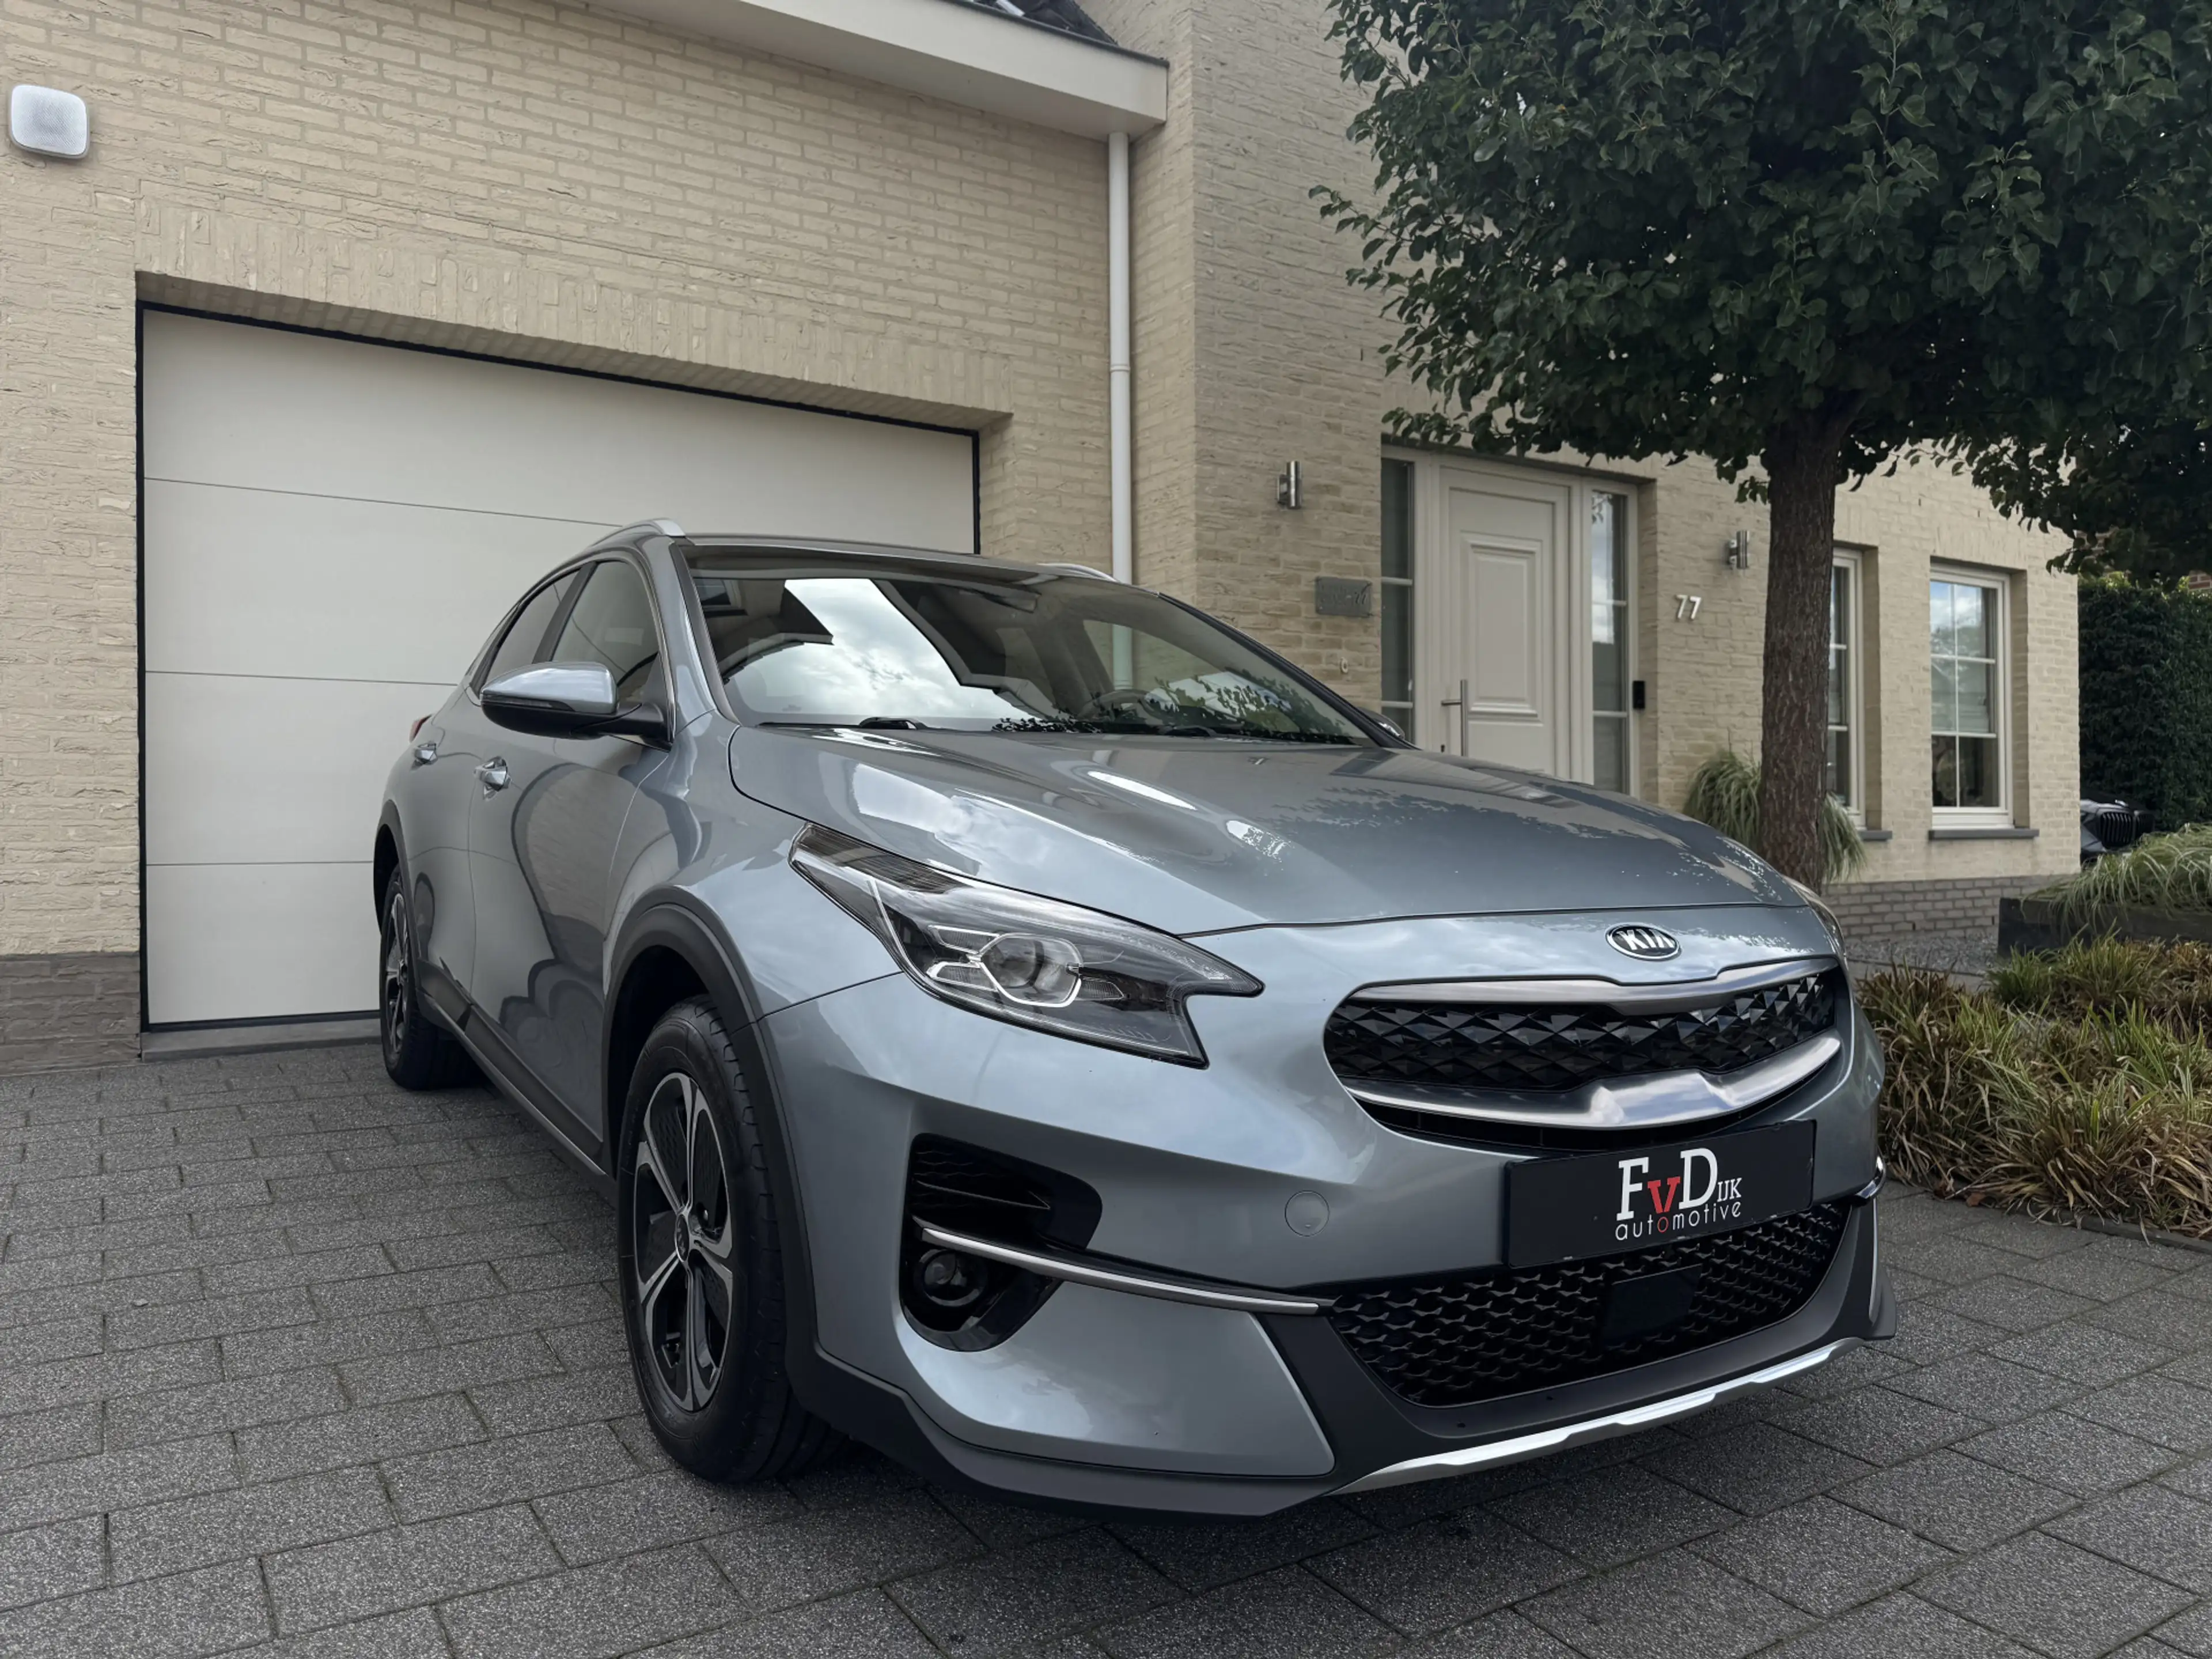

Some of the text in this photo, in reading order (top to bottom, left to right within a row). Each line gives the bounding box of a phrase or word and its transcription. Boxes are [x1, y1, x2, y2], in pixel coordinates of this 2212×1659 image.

[1676, 594, 1702, 619] 77
[1616, 928, 1675, 950] KIA
[1615, 1201, 1741, 1241] automotive
